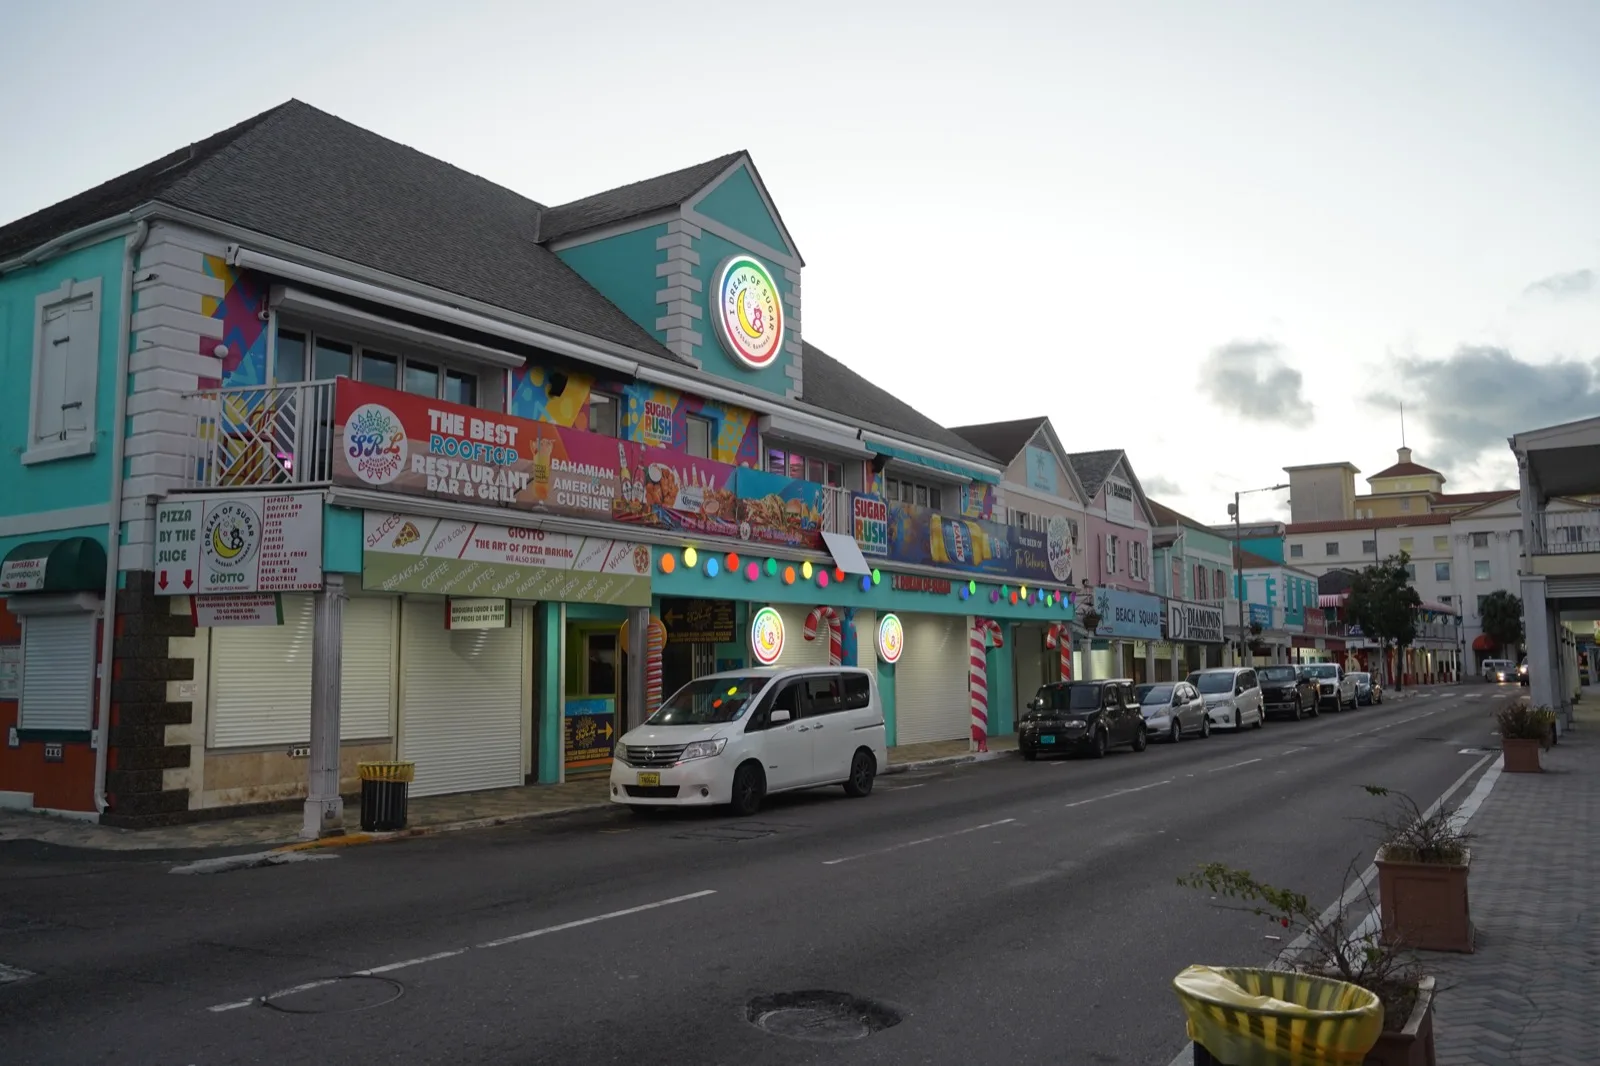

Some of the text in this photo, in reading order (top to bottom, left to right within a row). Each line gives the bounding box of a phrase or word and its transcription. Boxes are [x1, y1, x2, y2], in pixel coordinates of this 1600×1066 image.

[729, 274, 747, 305] DREAM
[751, 276, 760, 286] OF
[762, 288, 774, 331] SUGAR
[645, 402, 672, 419] SUGAR
[428, 408, 518, 446] THE BEST
[645, 416, 672, 436] RUSH
[349, 432, 404, 458] SRL
[430, 433, 518, 466] ROOFTOP
[412, 454, 530, 490] RESTAURANT
[552, 458, 614, 480] BAHAMIAN
[427, 476, 517, 502] BAR & GRILL
[554, 478, 614, 498] AMERICAN
[556, 492, 610, 511] CUISINE
[855, 499, 886, 521] SUGAR
[160, 509, 192, 523] PIZZA
[204, 513, 220, 547] DREAM
[222, 506, 233, 515] OF
[236, 508, 254, 537] SUGAR
[160, 529, 196, 543] BY THE
[367, 512, 402, 548] SLICES
[434, 541, 447, 552] HOT
[452, 525, 467, 538] COLD
[508, 528, 545, 540] GIOTTO
[856, 518, 886, 544] RUSH
[954, 525, 963, 557] KALIK
[475, 539, 573, 558] THE ART OF PIZZA MAKING
[1027, 538, 1036, 547] BEER
[158, 550, 186, 562] SLICE
[608, 542, 633, 570] WHOLE
[210, 573, 245, 584] GIOTTO
[382, 556, 429, 591] BREAKFAST
[421, 560, 450, 590] COFFEE
[468, 568, 495, 592] LATTES
[1116, 607, 1158, 628] BEACH SQUAD
[1188, 608, 1220, 628] DIAMONDS
[1188, 627, 1222, 640] INTERNATIONAL
